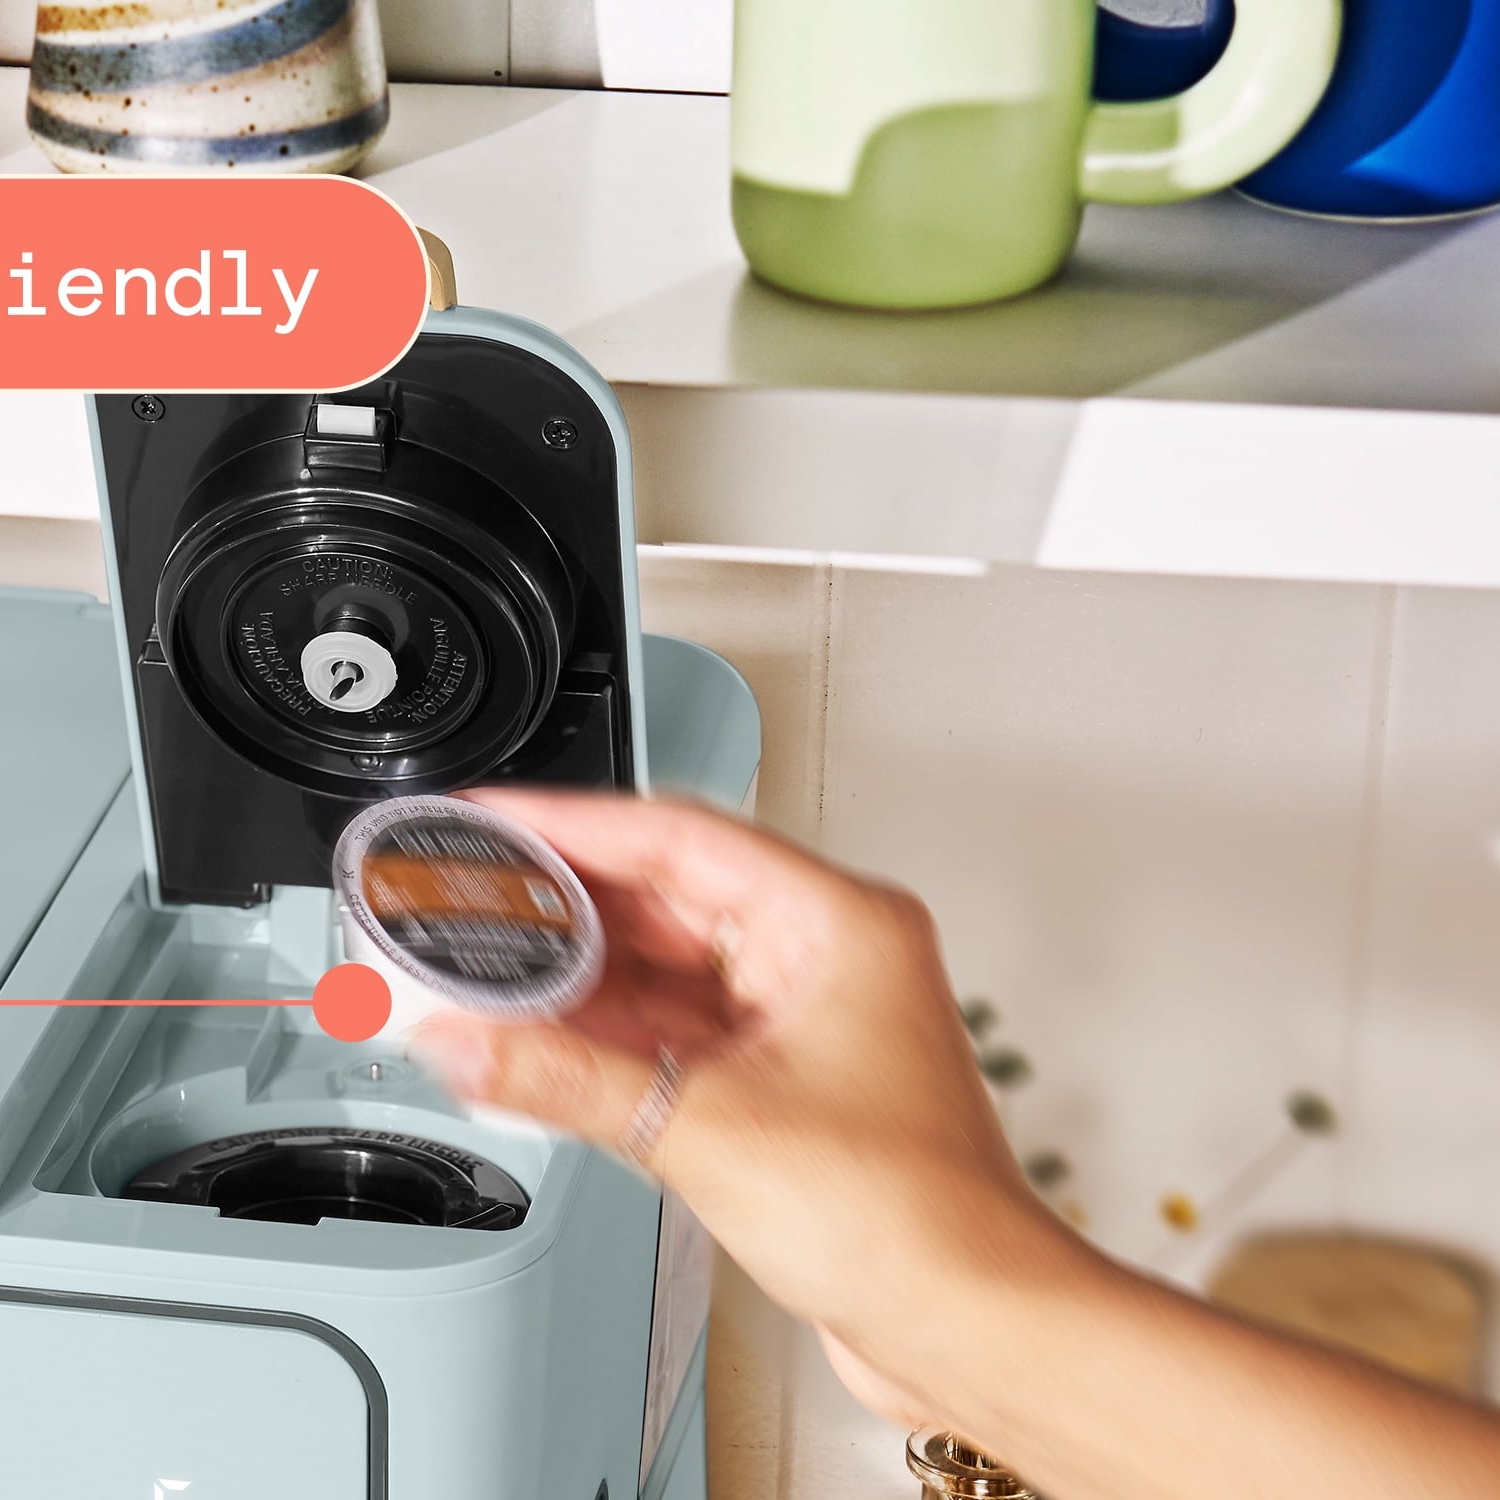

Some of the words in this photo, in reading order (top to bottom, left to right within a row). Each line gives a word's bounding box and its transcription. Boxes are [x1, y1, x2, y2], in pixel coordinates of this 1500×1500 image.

[302, 558, 393, 578] CAUTION:
[278, 573, 337, 597] SHARP
[345, 571, 419, 605] NEEDLE
